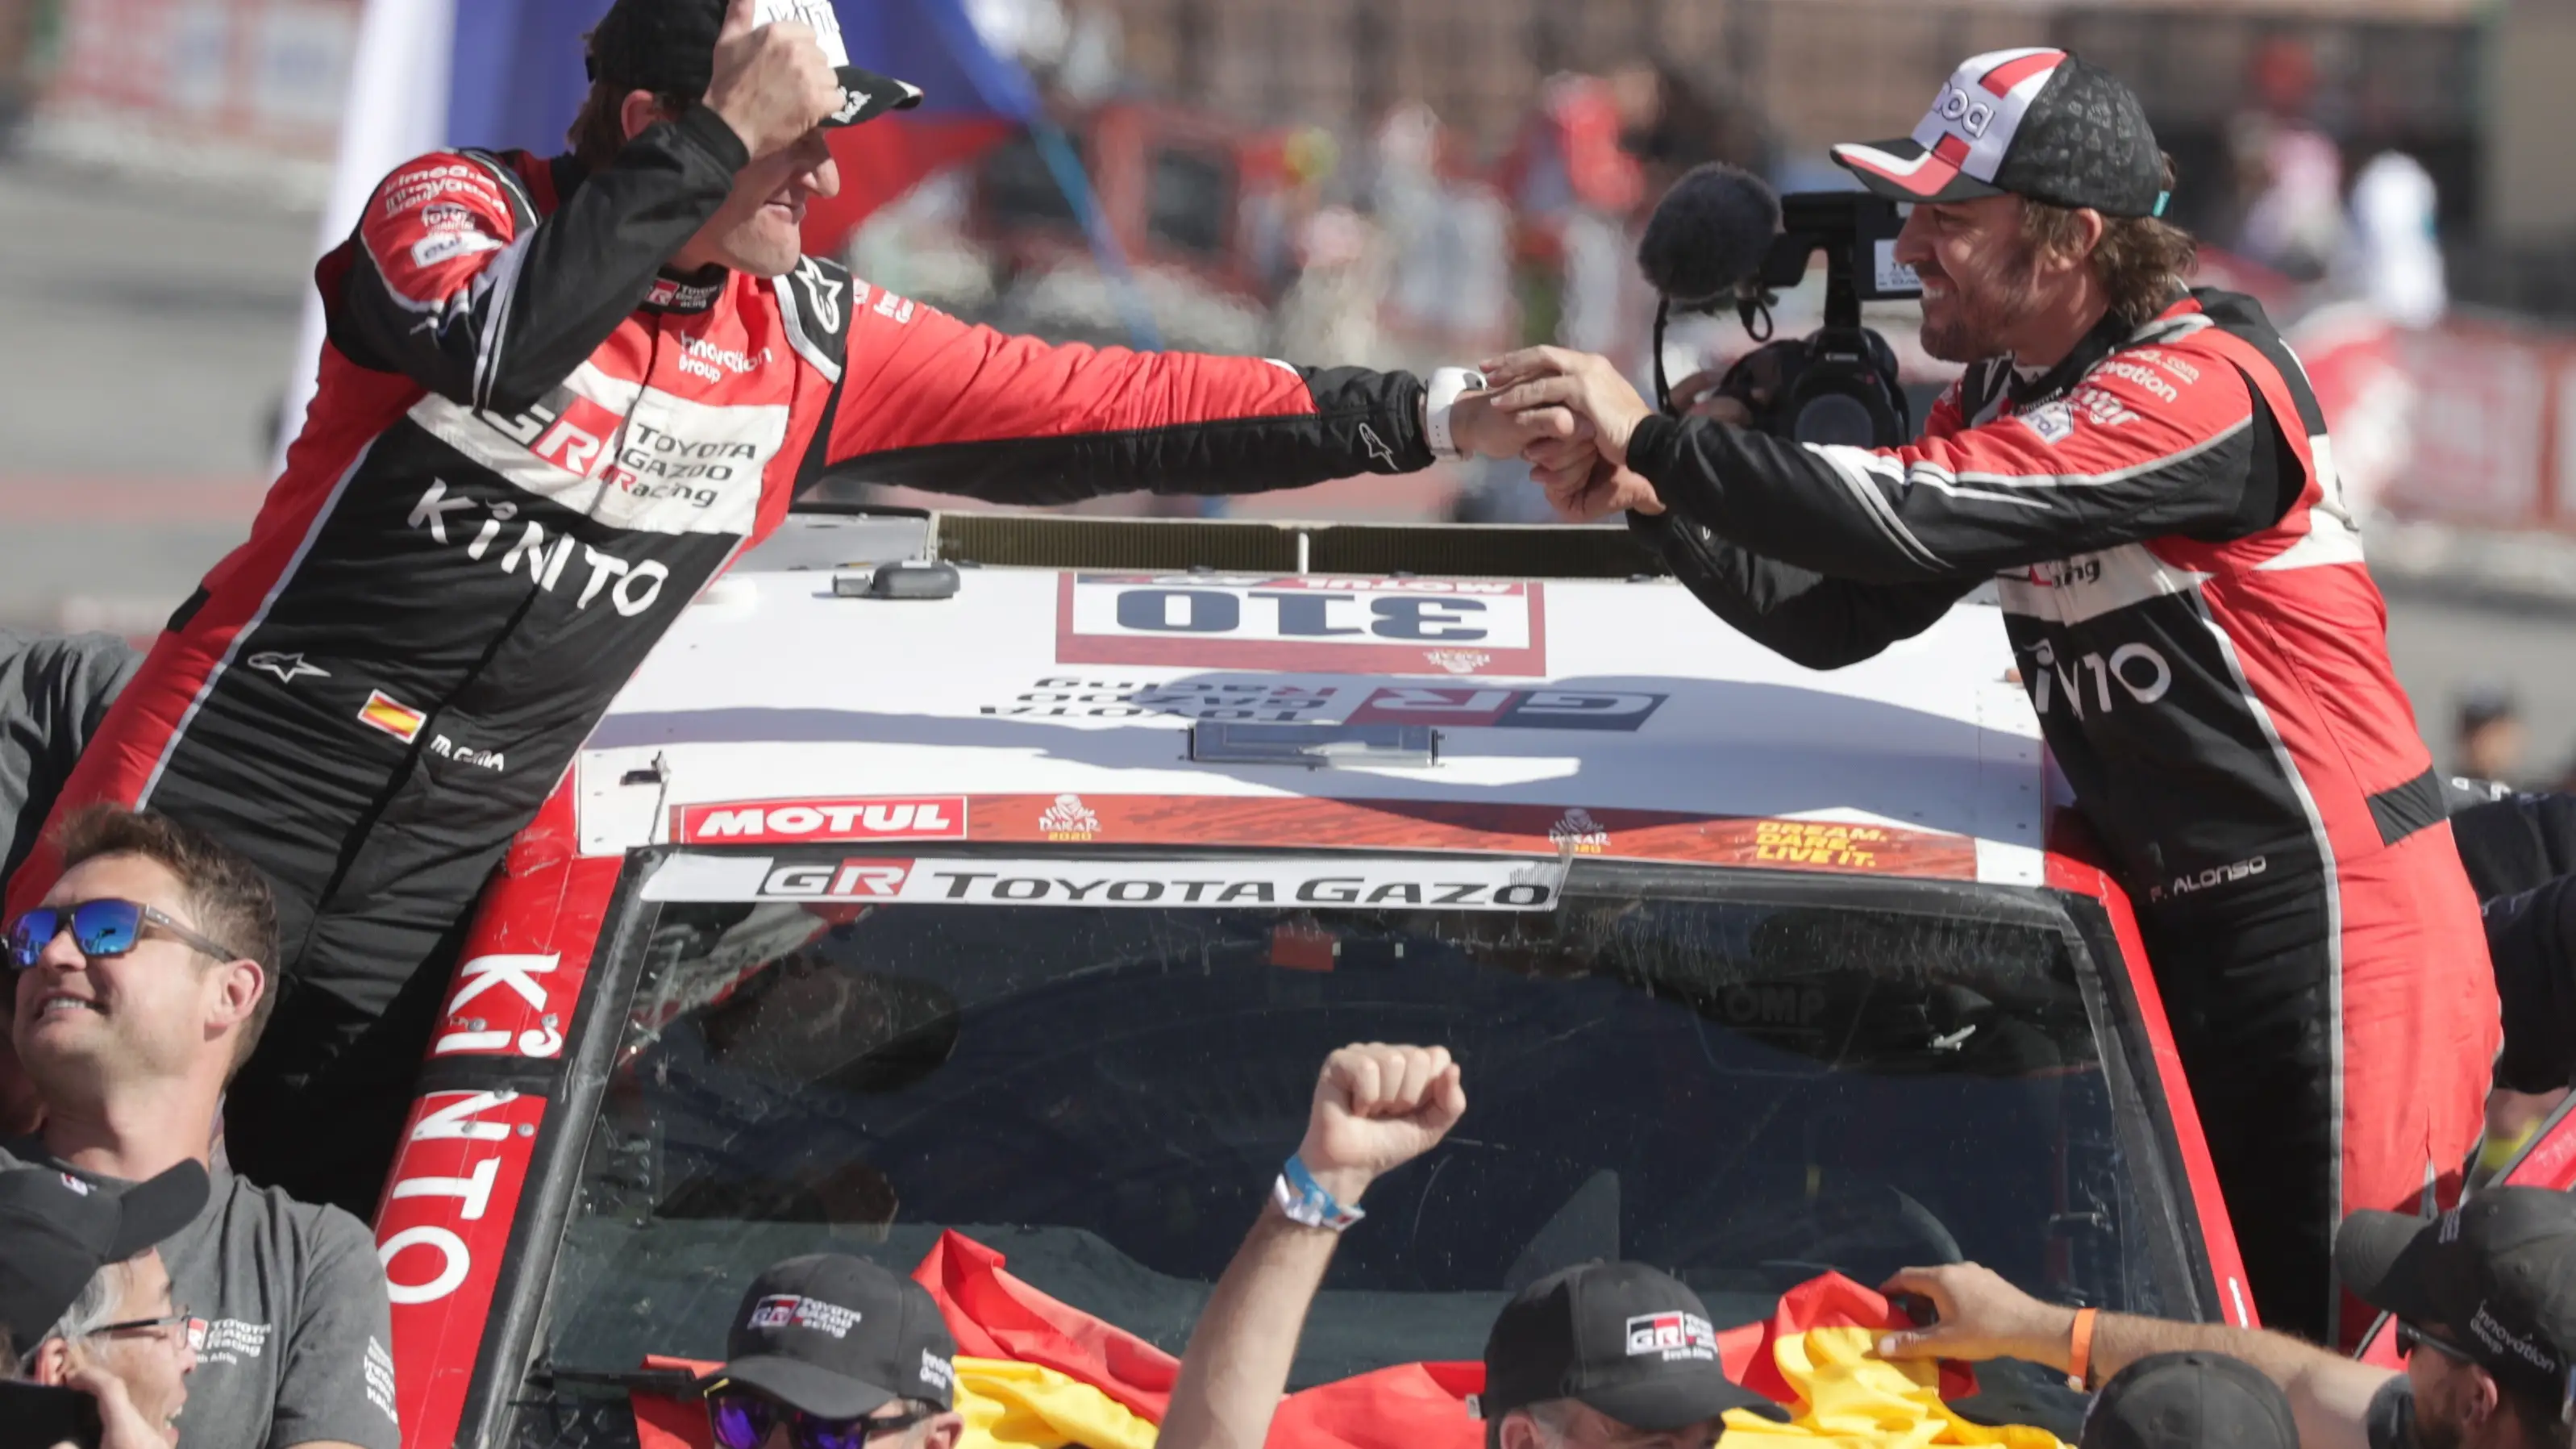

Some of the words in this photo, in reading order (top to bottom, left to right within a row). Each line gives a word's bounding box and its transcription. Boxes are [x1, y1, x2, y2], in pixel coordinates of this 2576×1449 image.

[636, 422, 758, 460] TOYOTA
[1116, 589, 1488, 642] 310
[696, 803, 952, 837] MOTUL
[1756, 833, 1858, 851] DARE.
[1756, 845, 1832, 864] LIVE
[761, 864, 905, 896] GR
[932, 872, 1276, 903] TOYOTA
[2173, 855, 2267, 897] ALONSO
